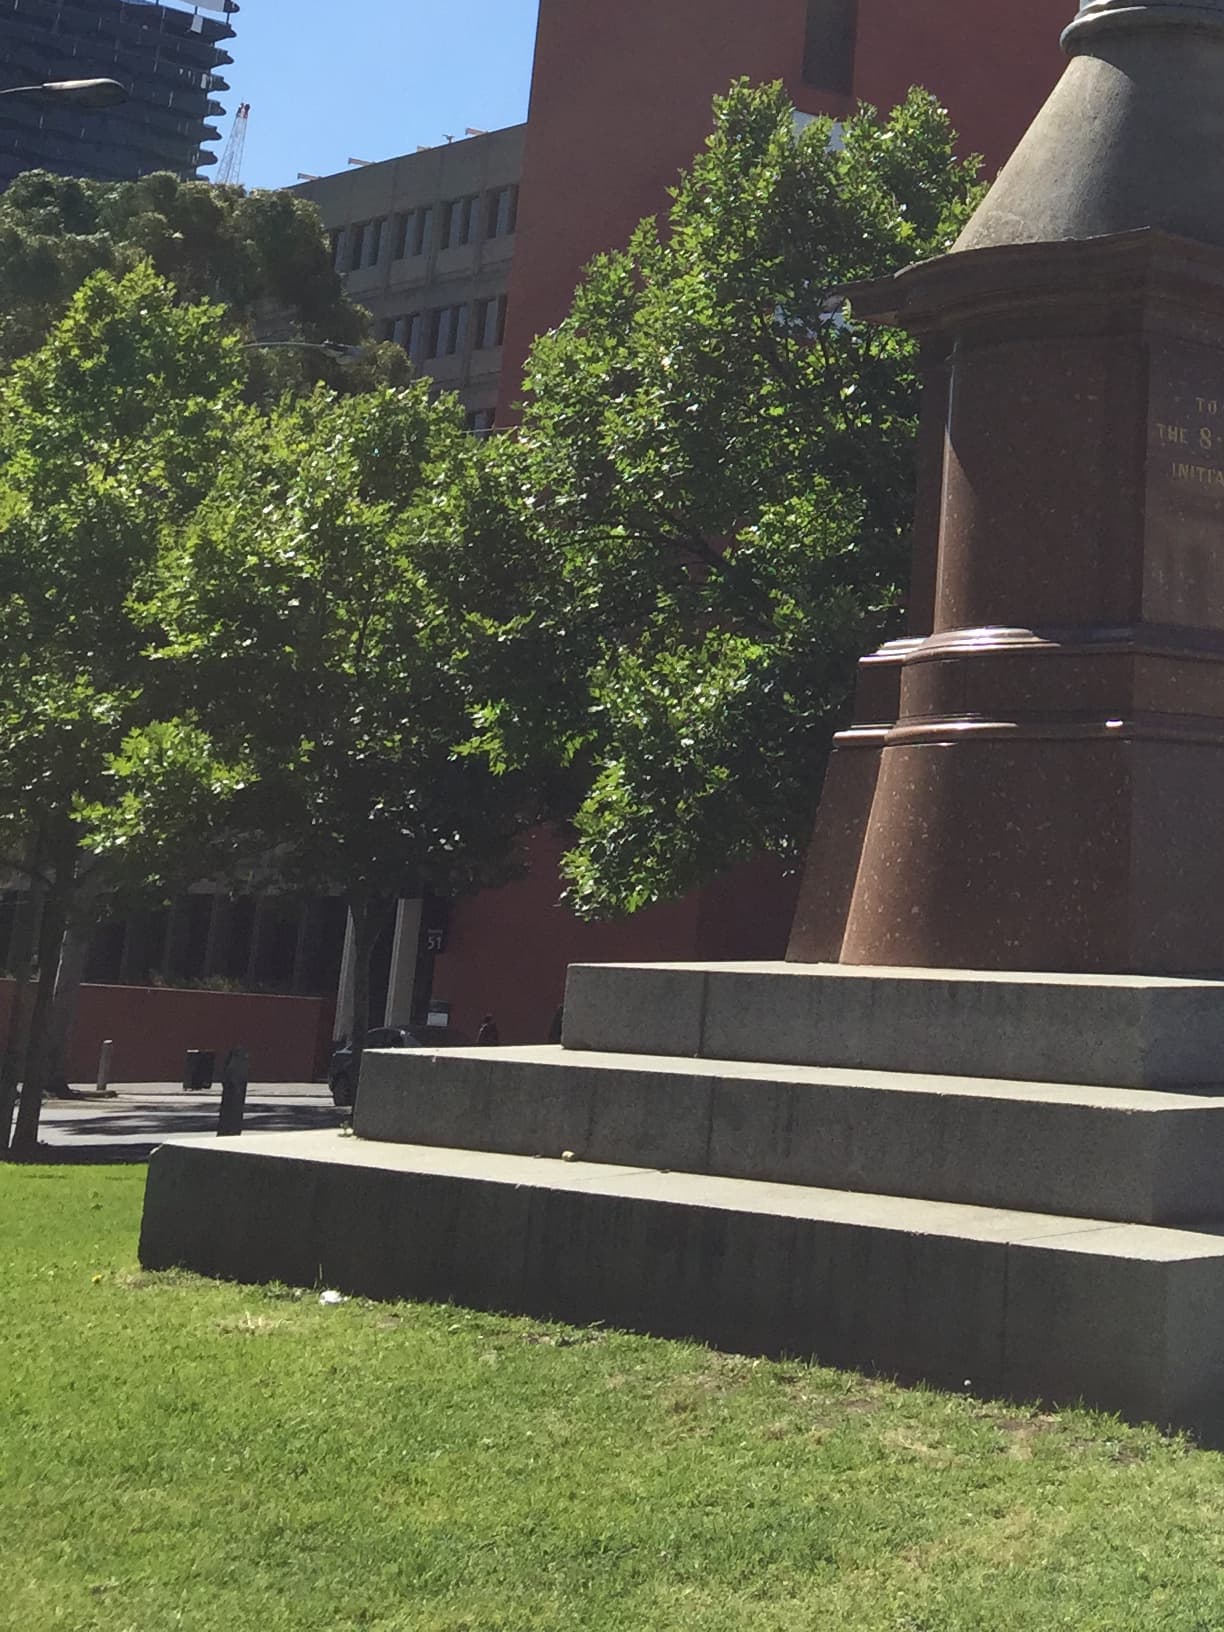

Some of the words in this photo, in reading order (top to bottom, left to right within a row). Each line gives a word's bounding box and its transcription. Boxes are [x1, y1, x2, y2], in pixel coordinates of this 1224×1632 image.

[1195, 396, 1218, 414] TO
[1156, 423, 1188, 445] THE
[1199, 426, 1213, 451] 8
[427, 935, 442, 950] 51
